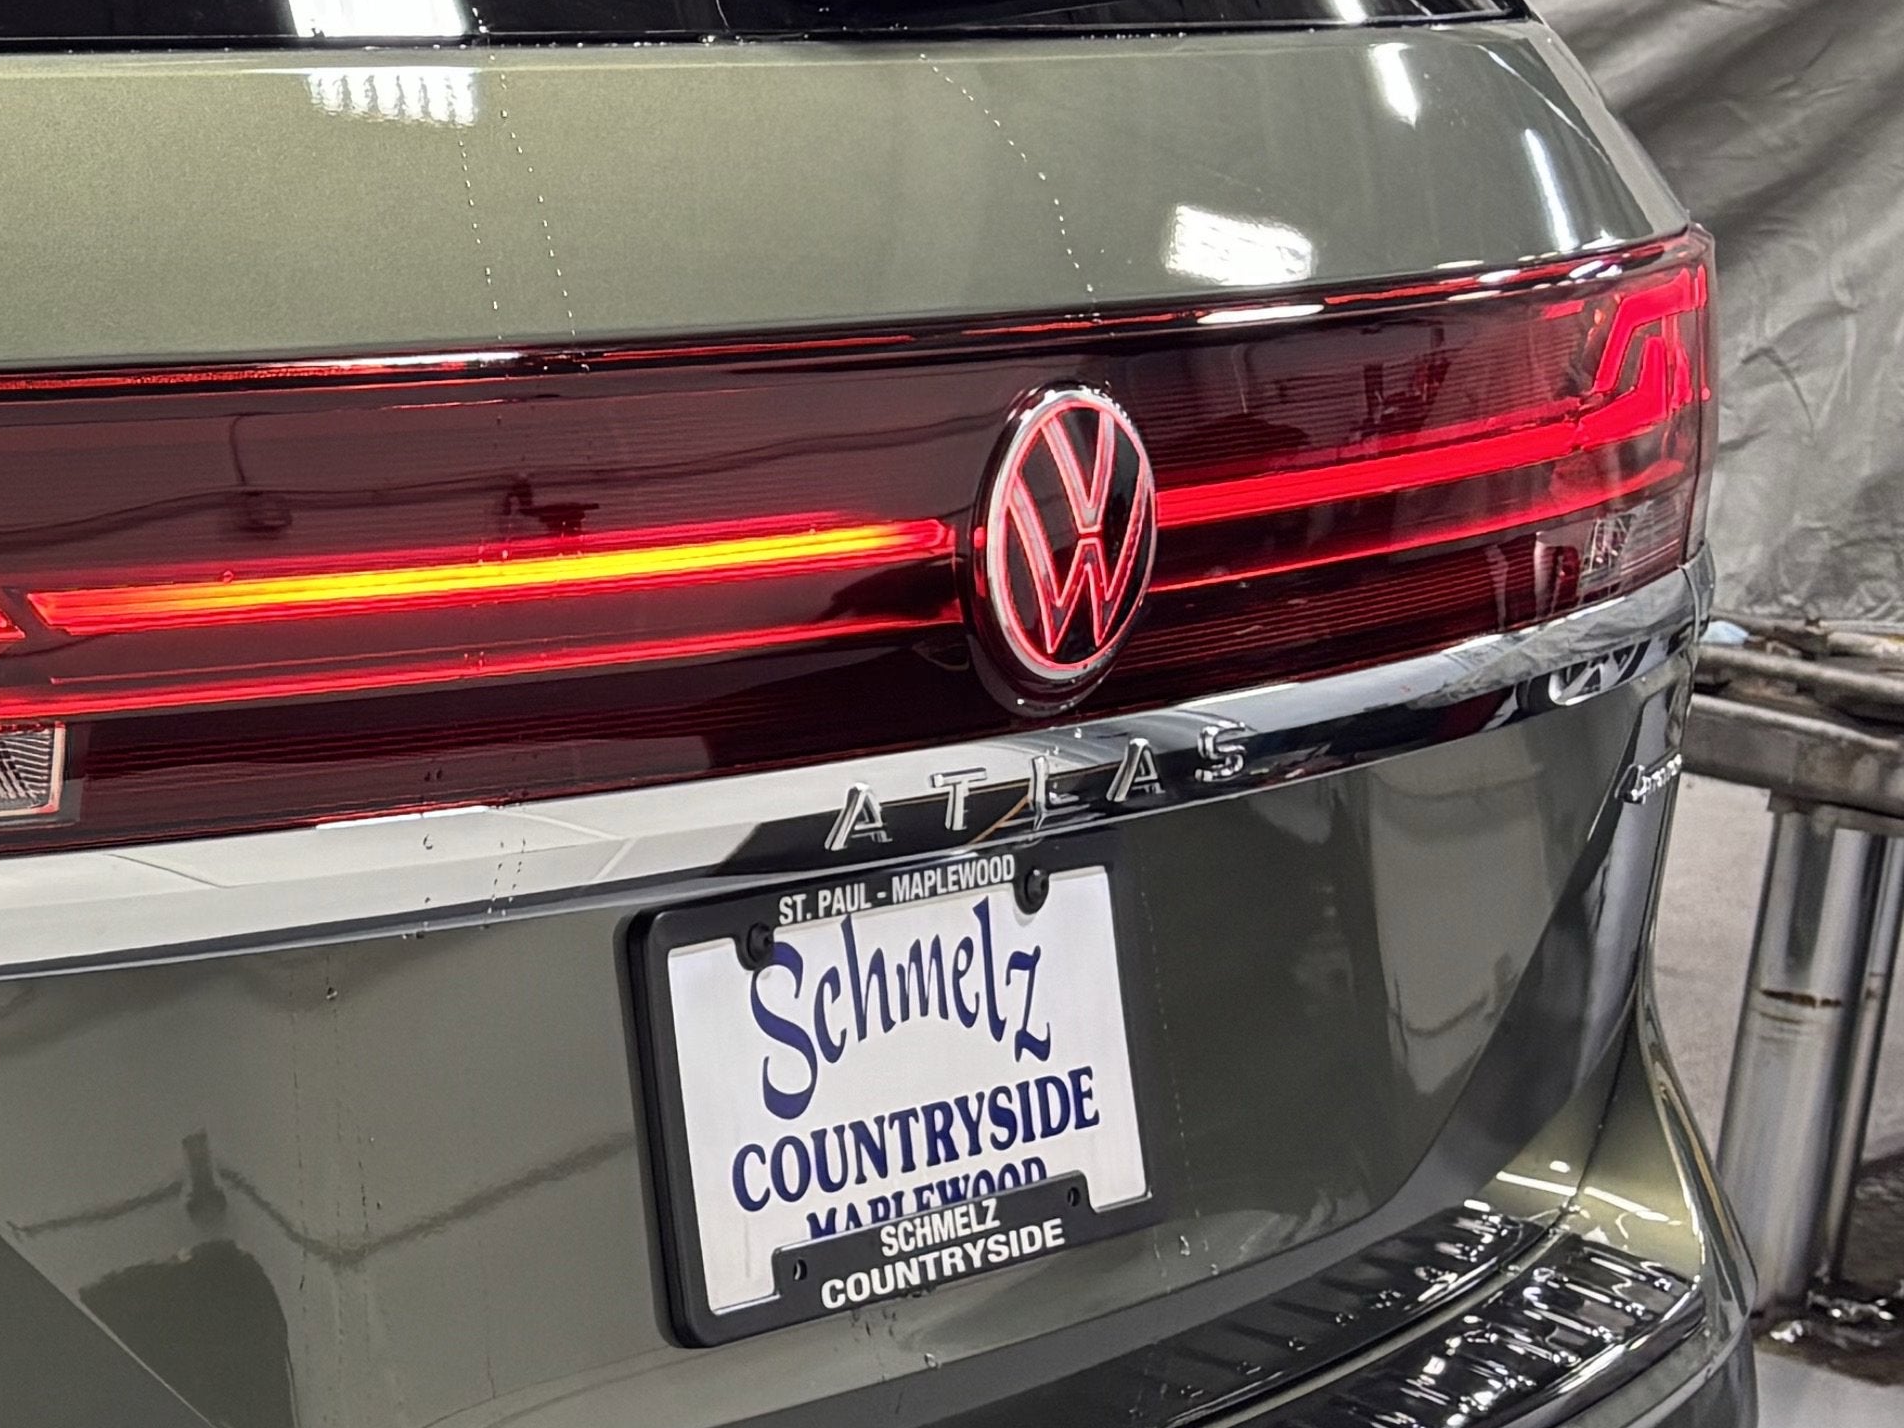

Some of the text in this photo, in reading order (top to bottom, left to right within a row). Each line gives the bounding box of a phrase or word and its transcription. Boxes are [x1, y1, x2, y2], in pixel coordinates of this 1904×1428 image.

[824, 722, 1248, 852] ATLAS
[778, 892, 812, 925] ST.
[817, 882, 872, 918] PAUL
[891, 853, 1016, 905] MAPLEWOOD
[749, 896, 1052, 1121] Schmelz
[731, 1065, 1101, 1213] COUNTRYSIDE
[820, 1217, 1066, 1310] COUNTRYSIDE
[879, 1197, 1001, 1257] SCHMELZ
